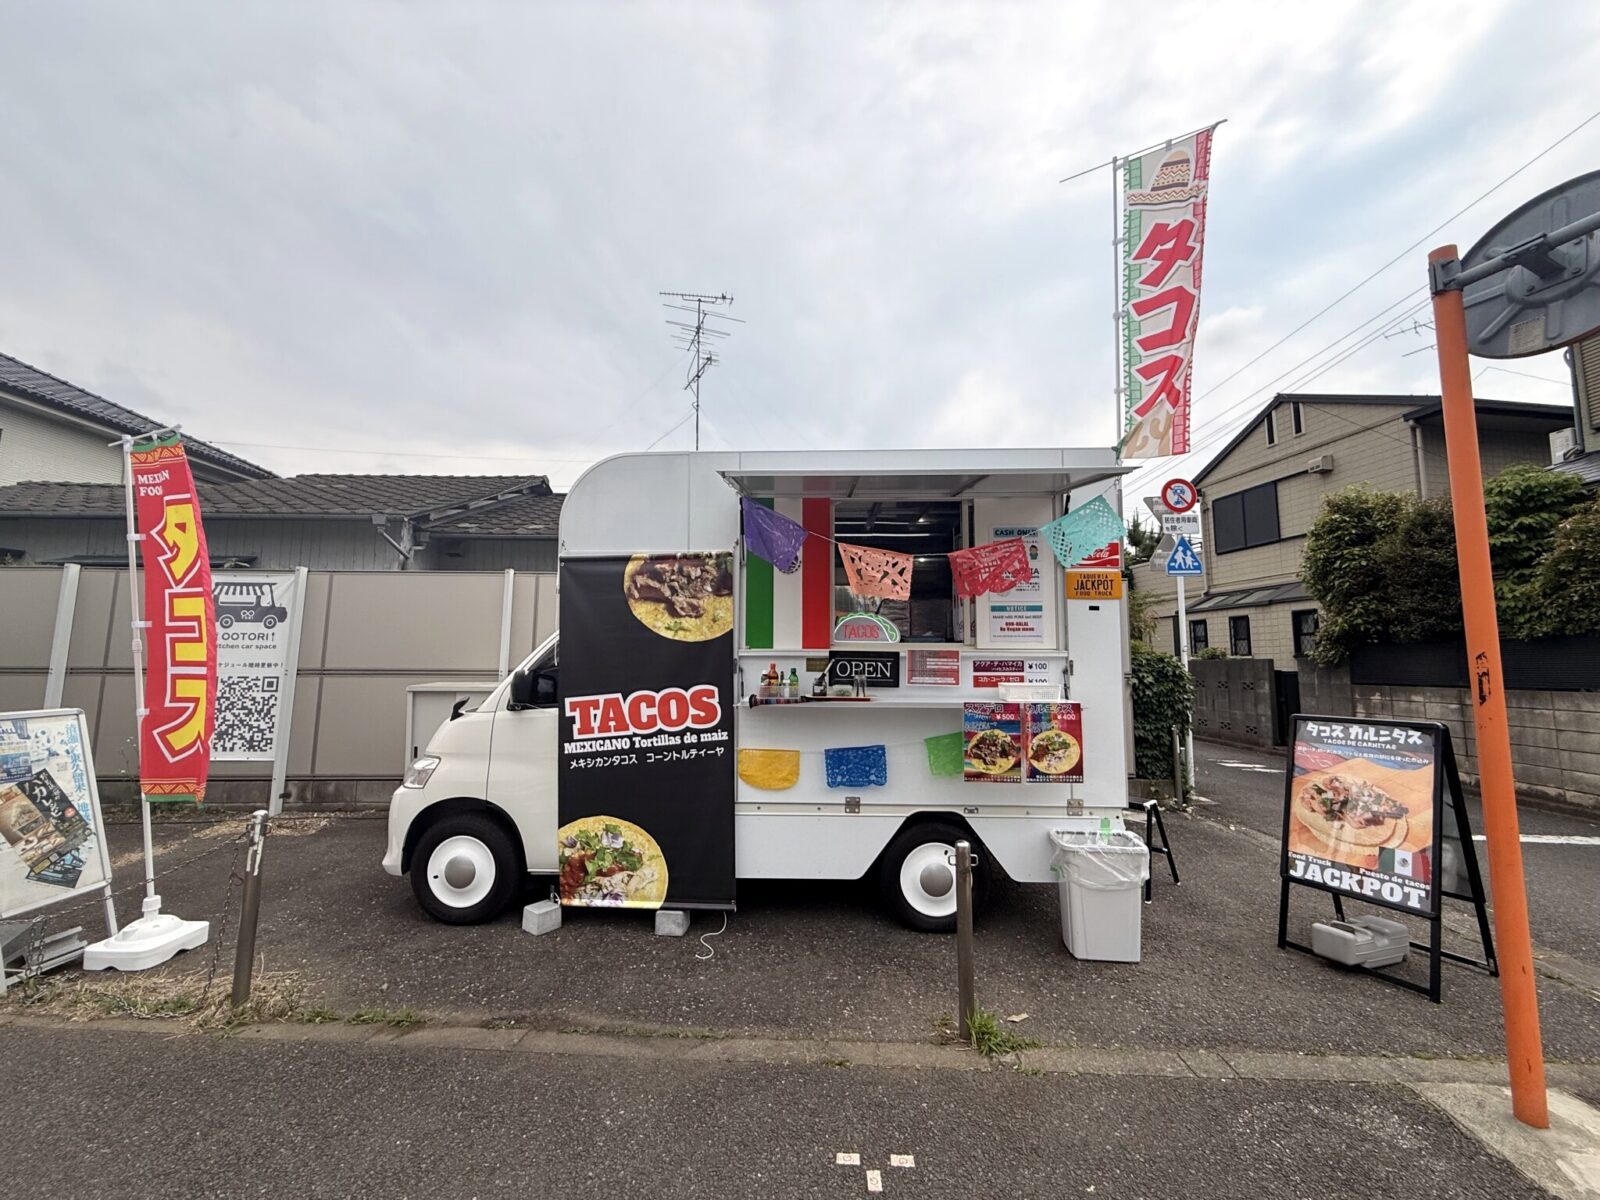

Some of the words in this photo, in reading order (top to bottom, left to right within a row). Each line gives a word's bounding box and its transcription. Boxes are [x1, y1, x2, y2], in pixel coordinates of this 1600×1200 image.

[1130, 217, 1198, 419] タコス
[1074, 580, 1114, 590] JACKPOT
[844, 623, 880, 639] TACOS
[836, 661, 892, 678] OPEN
[1028, 662, 1047, 670] ¥100
[565, 685, 721, 739] TACOS
[564, 738, 630, 754] MEXICANO
[633, 731, 681, 748] Tortillas
[683, 732, 698, 743] de
[700, 729, 728, 741] maiz
[1306, 722, 1344, 738] タコス
[1349, 724, 1423, 745] カルニタス
[1323, 738, 1346, 746] TACOS
[1357, 741, 1397, 750] CARNITAS
[569, 753, 638, 769] メキシカンタコス
[646, 746, 724, 762] コーントルティーヤ
[1288, 851, 1306, 860] Food
[1307, 855, 1332, 867] Truck
[1289, 860, 1426, 908] JACKPOT
[1360, 867, 1390, 880] Puesto
[1392, 875, 1403, 883] de
[1405, 879, 1431, 889] tacos
